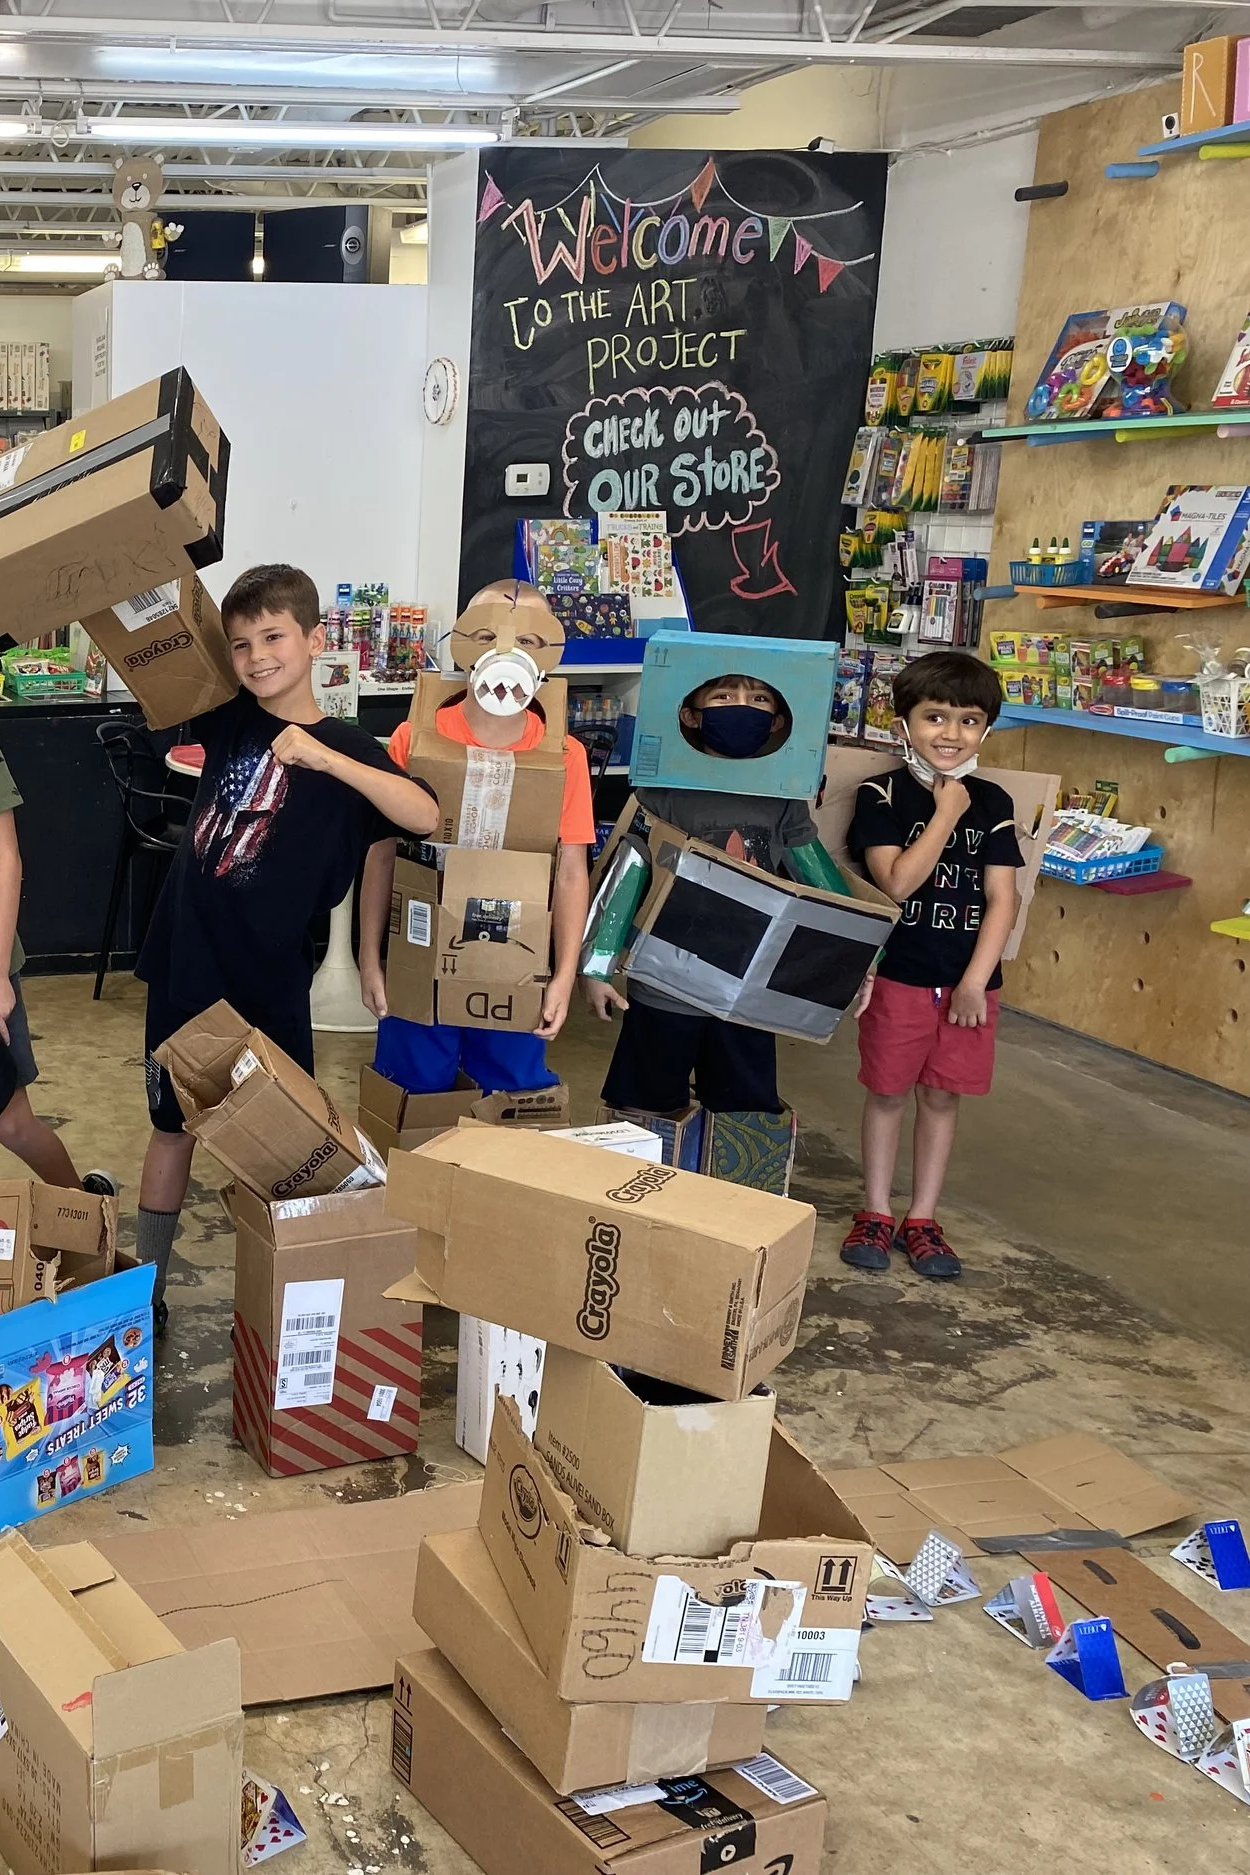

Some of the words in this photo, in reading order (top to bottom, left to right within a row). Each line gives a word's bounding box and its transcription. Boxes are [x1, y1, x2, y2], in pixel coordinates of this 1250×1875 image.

[1190, 52, 1217, 124] R
[500, 196, 763, 285] Welcome
[561, 288, 612, 323] THE
[625, 278, 697, 328] ART
[587, 327, 748, 396] PROJECT
[583, 407, 664, 459] CHECK
[587, 464, 661, 513] OUR
[638, 523, 664, 531] TRAINS
[1181, 512, 1227, 521] MAGNA-TILES
[553, 576, 568, 585] Little
[569, 576, 583, 587] Cozy
[556, 584, 581, 593] Critters
[124, 631, 194, 668] Crayola
[271, 1141, 339, 1198] Crayola
[606, 1165, 678, 1203] Crayola
[34, 1262, 45, 1291] 040
[576, 1221, 621, 1341] Crayola
[88, 1398, 123, 1427] SWEET
[126, 1385, 146, 1409] 32
[46, 1422, 87, 1456] TREATS
[548, 1429, 562, 1453] Item
[562, 1447, 581, 1471] #2500
[545, 1451, 566, 1480] SANDS
[585, 1489, 602, 1516] SAND
[601, 1507, 615, 1531] BOX
[827, 1594, 842, 1602] Way
[842, 1595, 853, 1603] Up
[797, 1630, 826, 1641] 10003
[8, 1716, 29, 1755] CHINA
[42, 1761, 61, 1800] MADE
[670, 1779, 700, 1795] ime
